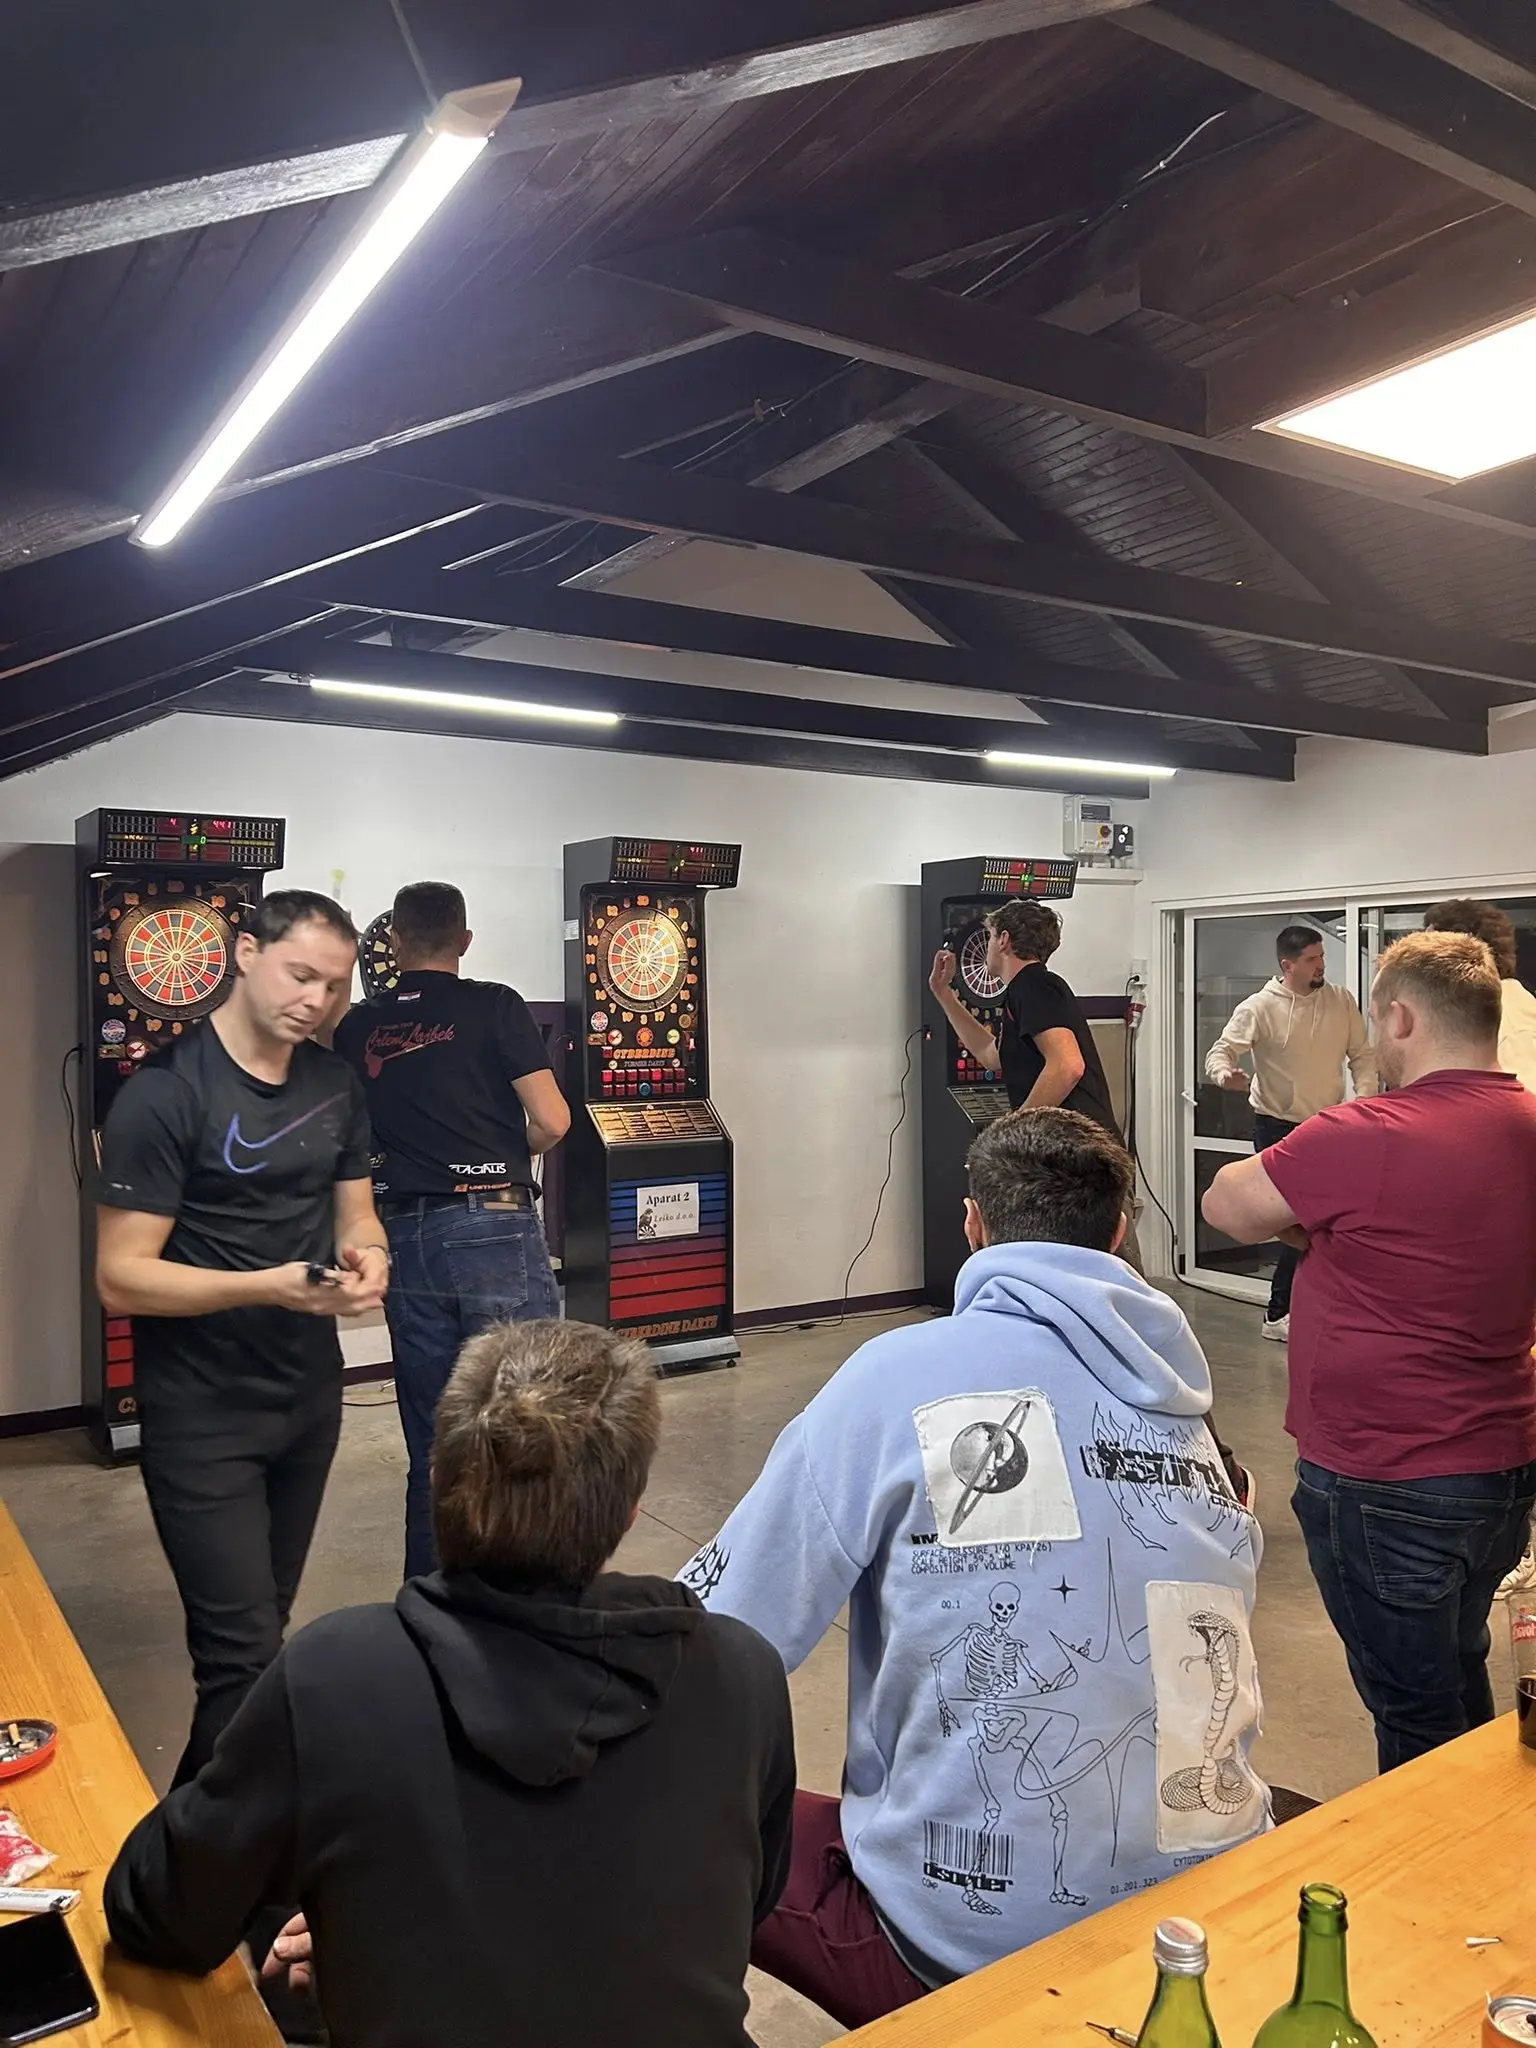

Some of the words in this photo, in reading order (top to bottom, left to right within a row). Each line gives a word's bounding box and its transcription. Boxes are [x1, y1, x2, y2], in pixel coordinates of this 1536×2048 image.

[646, 1193, 681, 1207] Aparat
[683, 1191, 690, 1201] 2
[948, 1545, 989, 1556] PRESSURE
[940, 1555, 968, 1565] HEIGHT
[911, 1563, 964, 1575] COMPOSITION
[968, 1562, 979, 1573] BY
[984, 1560, 1017, 1571] VOLUME
